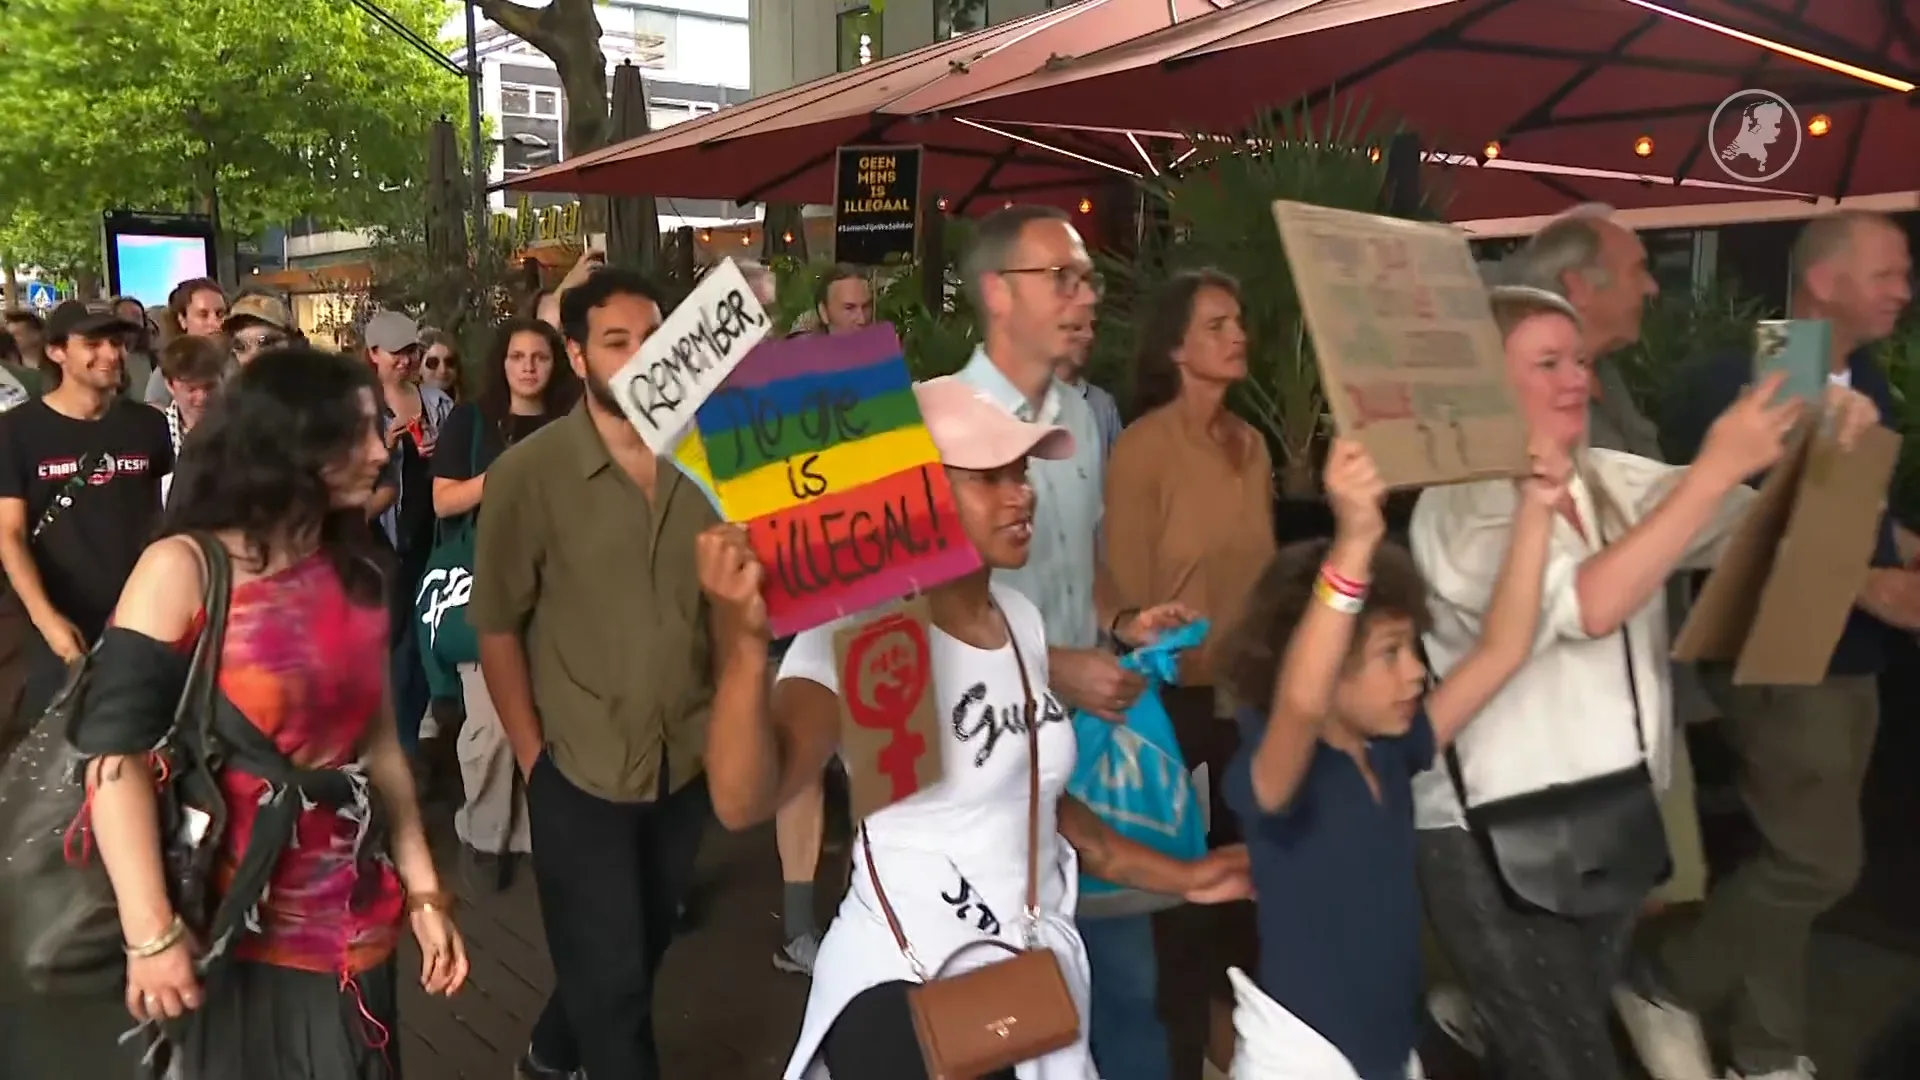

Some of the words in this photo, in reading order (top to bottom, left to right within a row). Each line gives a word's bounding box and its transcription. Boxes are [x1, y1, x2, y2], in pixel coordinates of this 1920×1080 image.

[858, 156, 896, 170] GEEN
[857, 170, 897, 185] MENS
[870, 185, 886, 198] IS
[844, 198, 910, 213] ILLEGAAL
